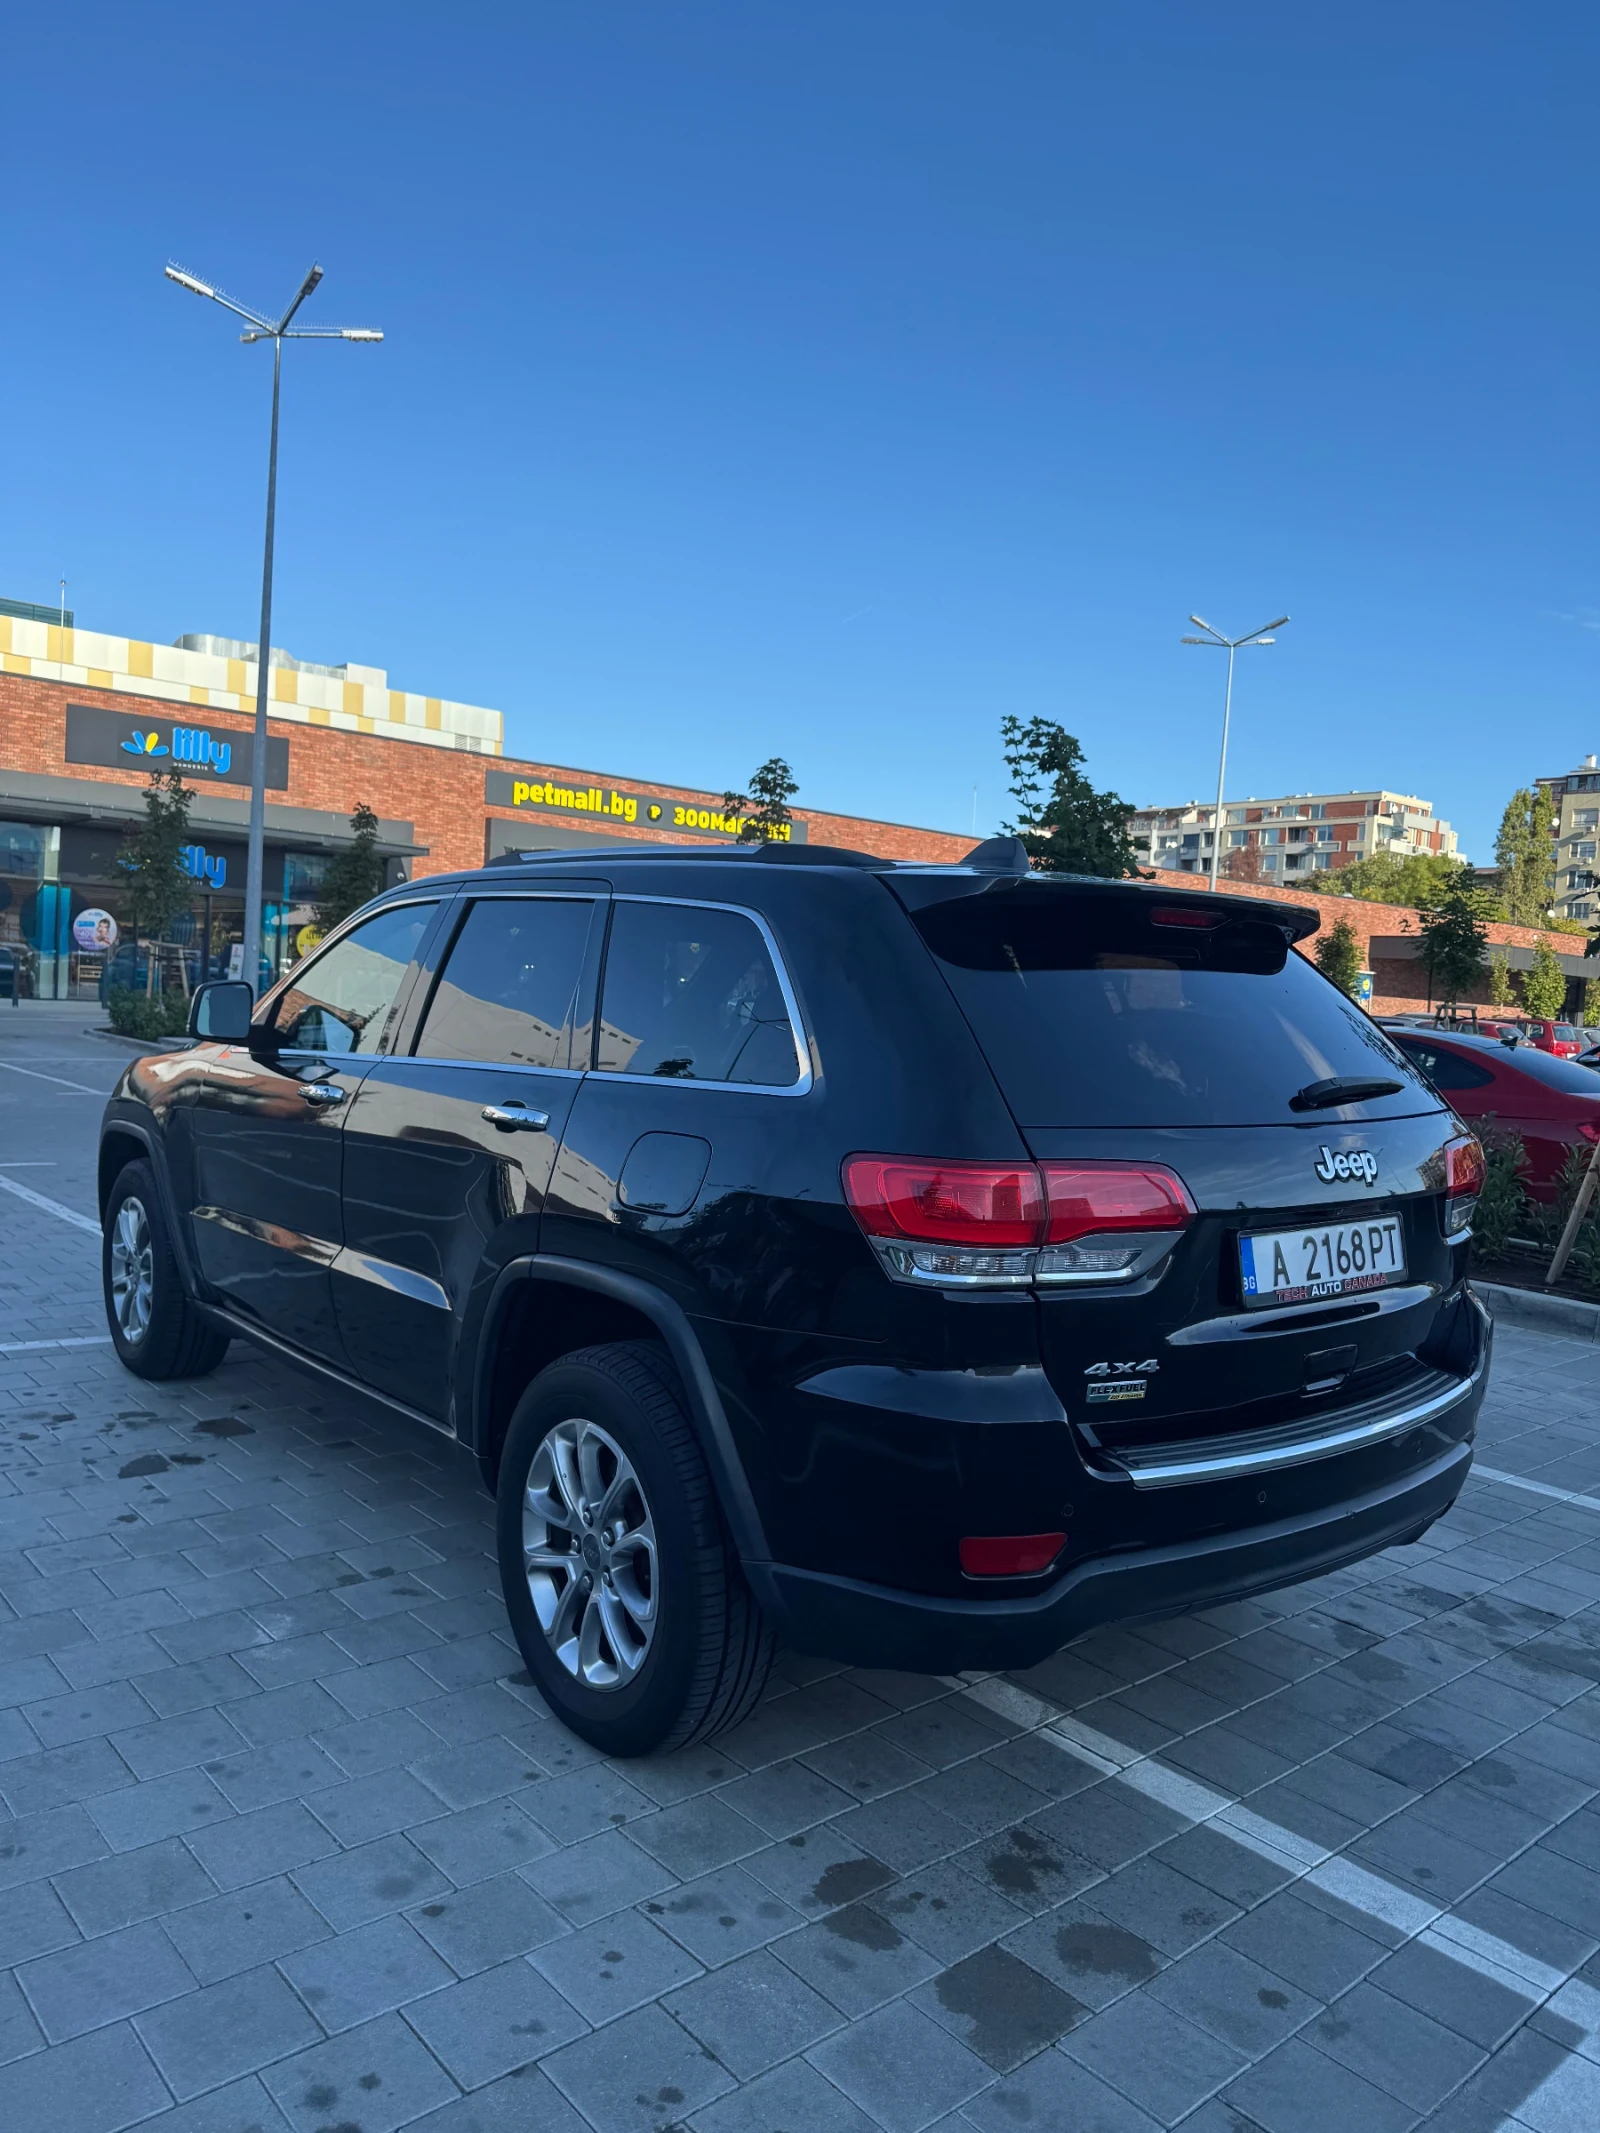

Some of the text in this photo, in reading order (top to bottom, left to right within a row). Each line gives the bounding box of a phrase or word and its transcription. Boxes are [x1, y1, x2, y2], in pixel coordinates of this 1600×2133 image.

[172, 727, 231, 774] lilly
[513, 781, 637, 822] petmall.bg
[1314, 1145, 1378, 1187] Jeep
[1273, 1240, 1291, 1287] A
[1276, 1272, 1388, 1302] TECH AUTO CANADA
